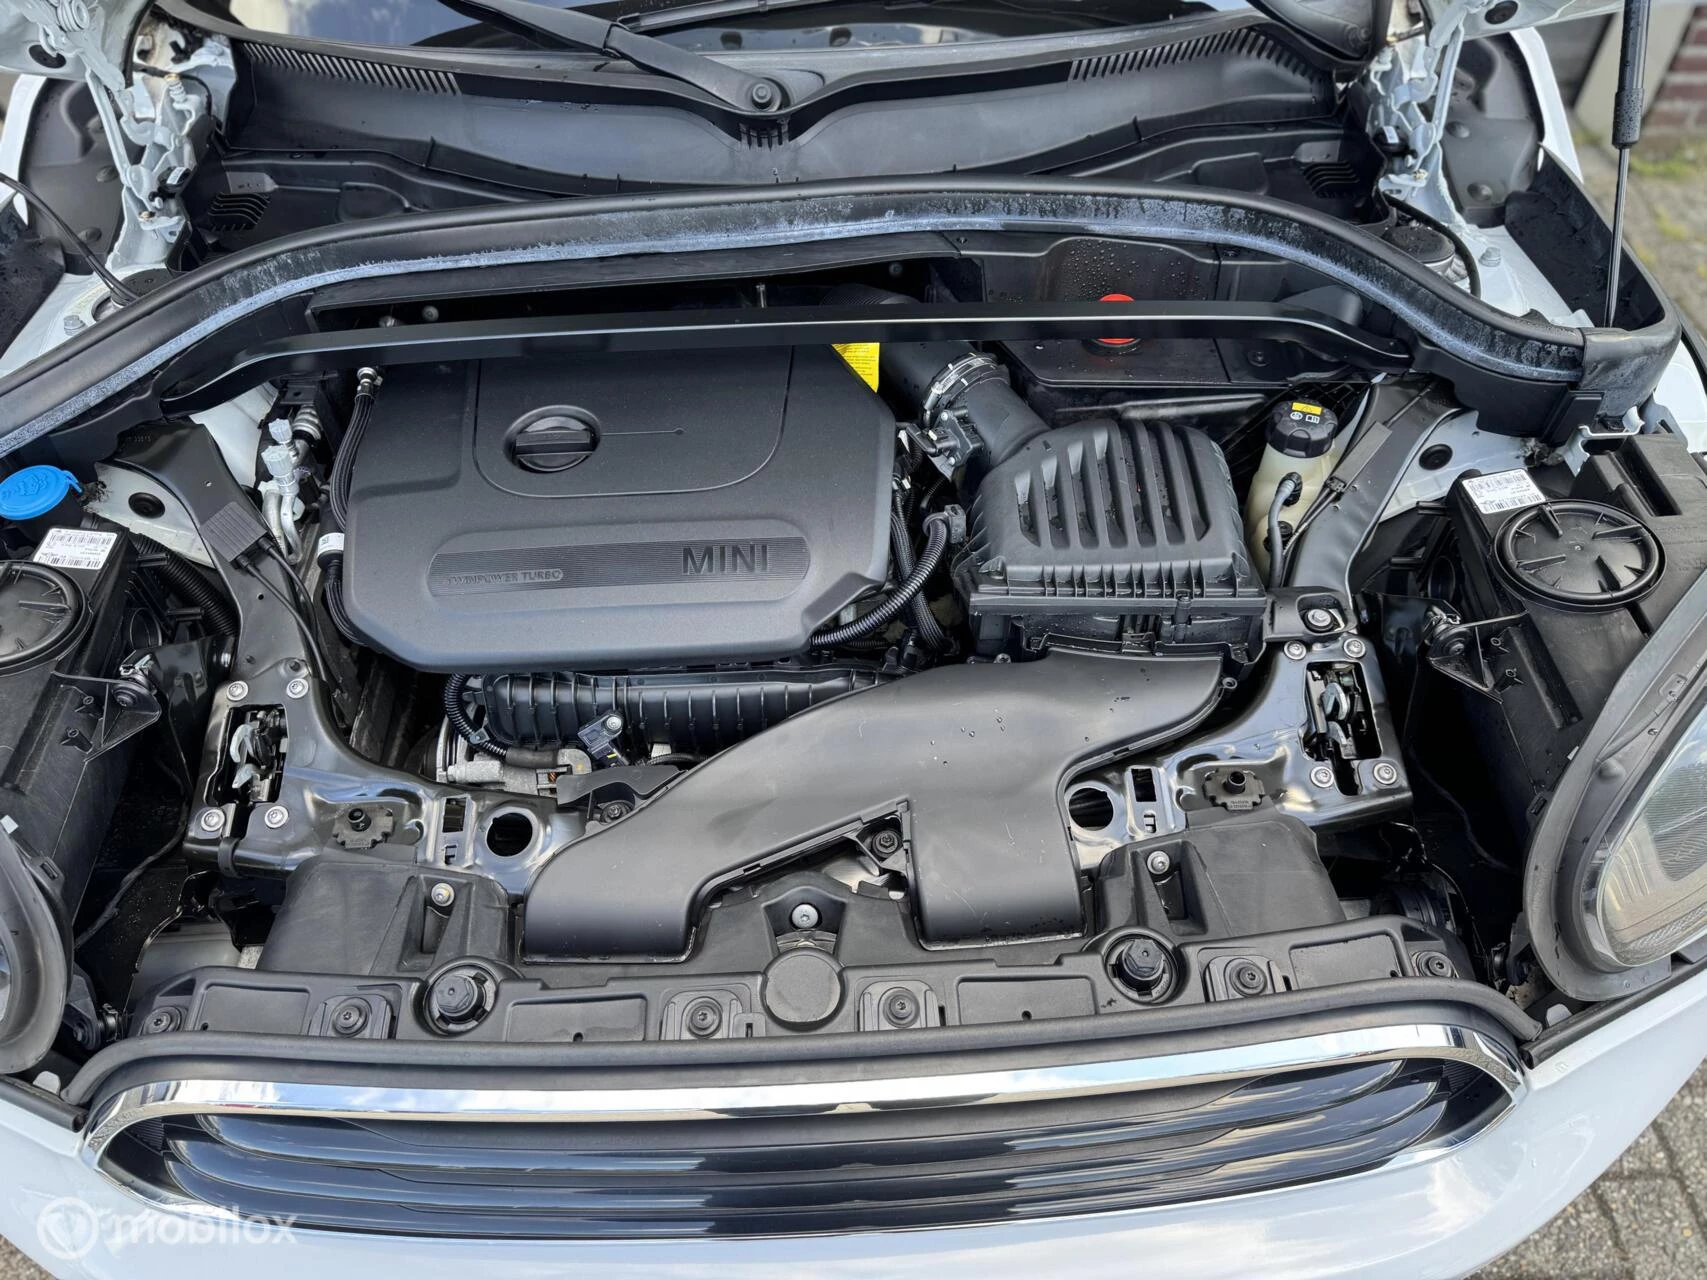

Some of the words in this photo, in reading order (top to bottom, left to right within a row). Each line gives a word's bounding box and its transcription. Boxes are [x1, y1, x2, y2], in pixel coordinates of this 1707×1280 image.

[683, 543, 768, 575] MINI
[447, 572, 518, 585] TWINPOWER
[522, 569, 561, 581] TURBO
